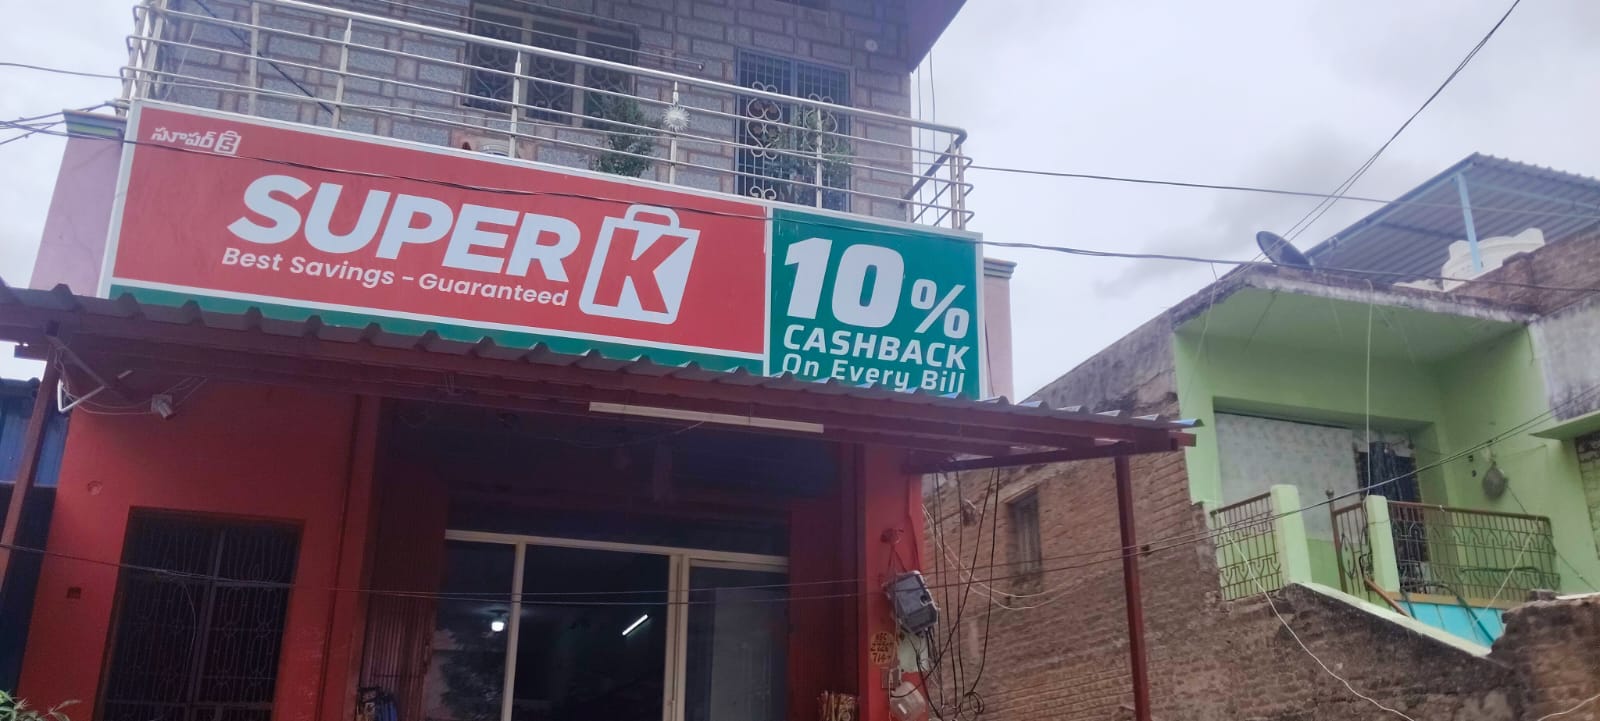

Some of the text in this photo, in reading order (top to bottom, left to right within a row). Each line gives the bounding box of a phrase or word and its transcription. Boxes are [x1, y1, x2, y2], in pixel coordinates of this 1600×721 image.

[227, 174, 690, 315] SUPER K
[222, 247, 283, 272] Best
[290, 255, 395, 289] Savings
[418, 273, 569, 307] Guaranteed
[782, 353, 965, 393] On Every Bill
[783, 324, 971, 370] CASHBACK
